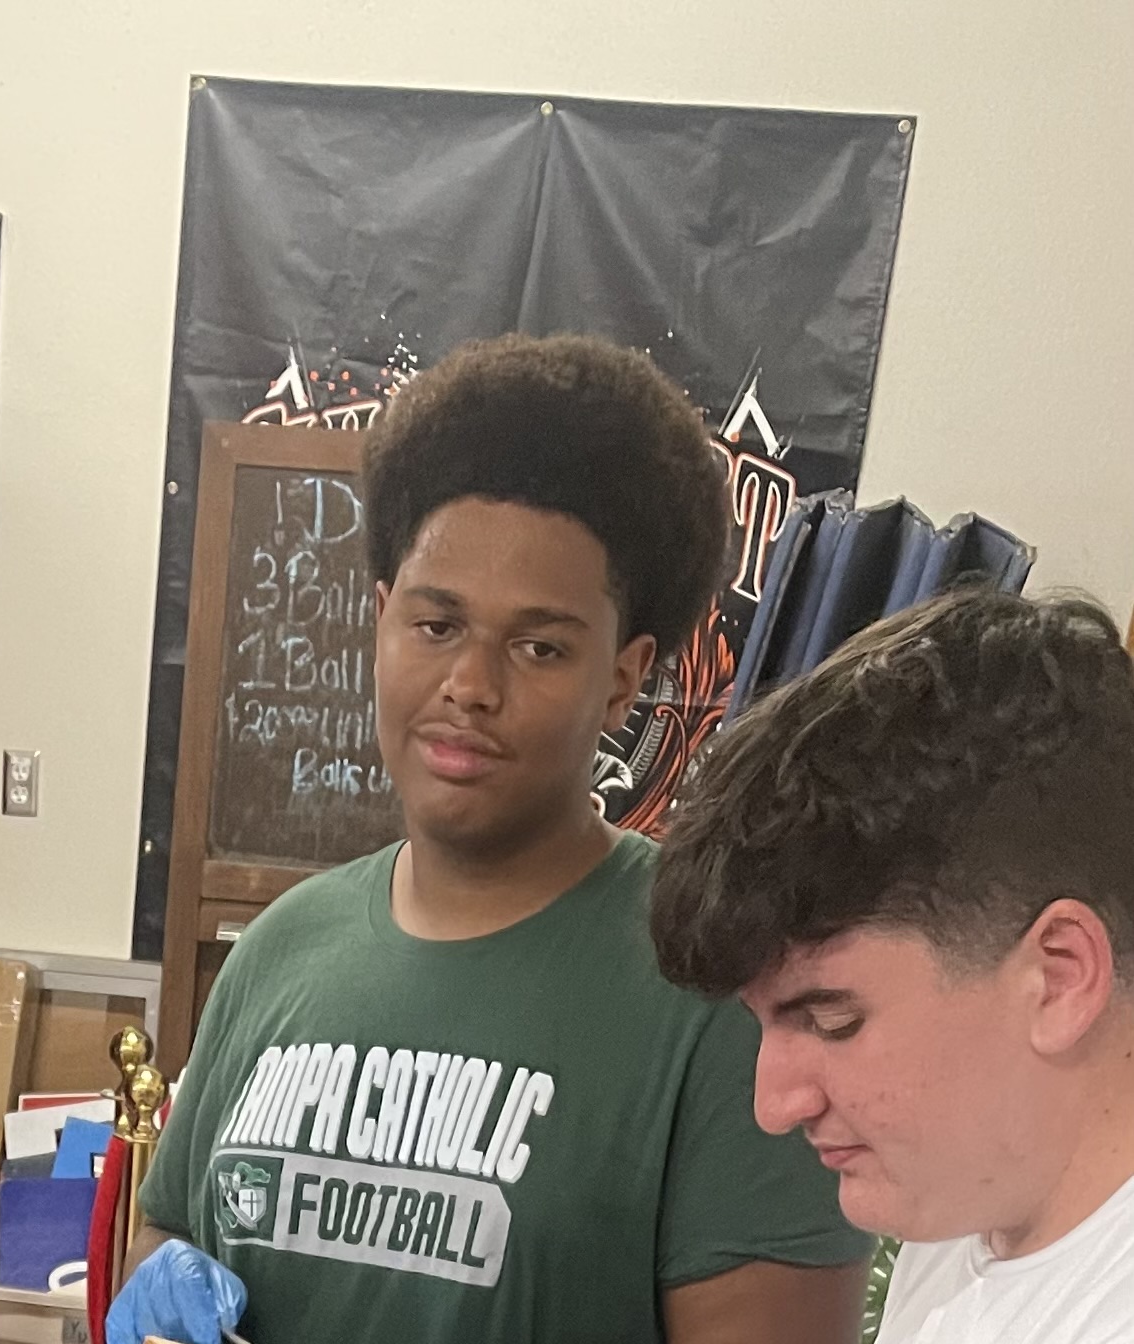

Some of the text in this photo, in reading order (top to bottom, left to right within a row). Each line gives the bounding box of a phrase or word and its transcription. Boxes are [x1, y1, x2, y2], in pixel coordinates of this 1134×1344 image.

[220, 1042, 556, 1184] AMPA CATHOLIC
[288, 1172, 487, 1269] FOOTBALL
